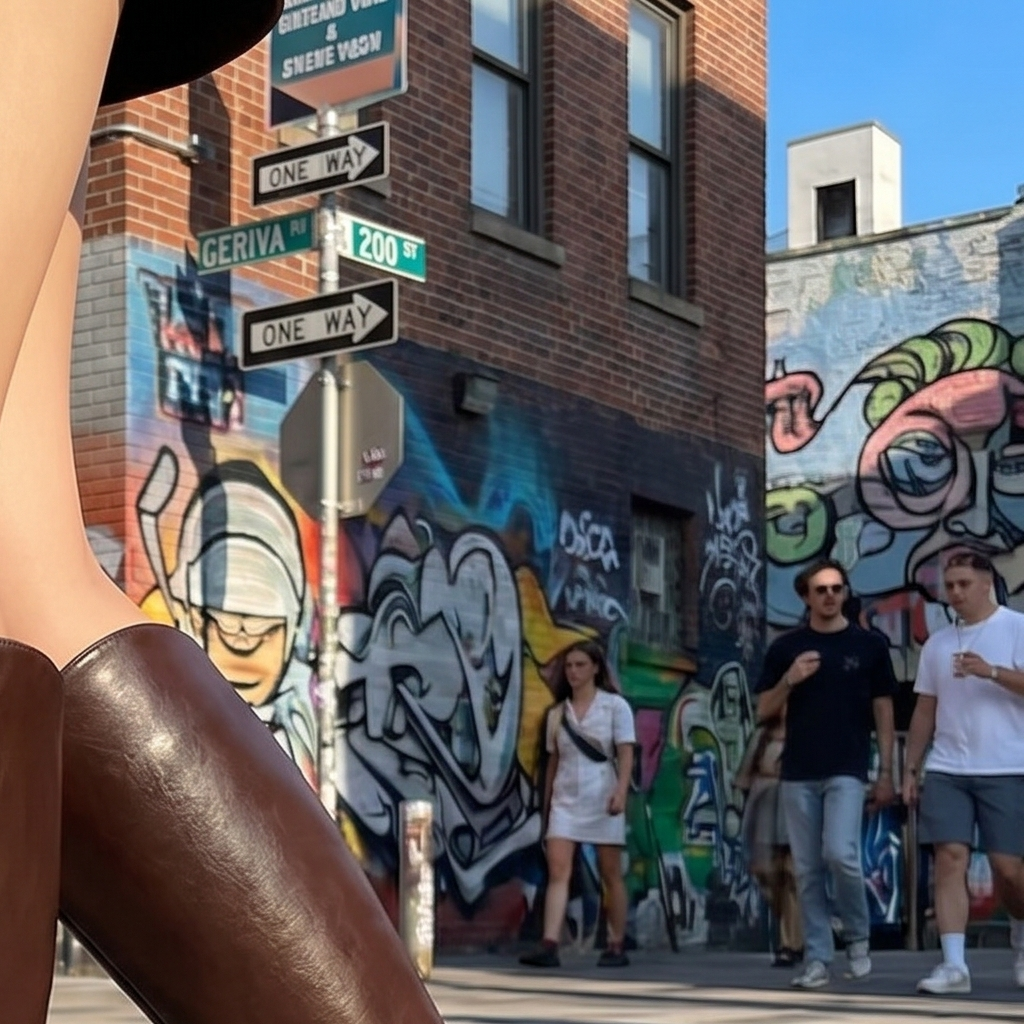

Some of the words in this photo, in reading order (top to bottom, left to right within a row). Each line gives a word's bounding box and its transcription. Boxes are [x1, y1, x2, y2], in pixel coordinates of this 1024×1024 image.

[269, 160, 309, 188] ONE
[326, 145, 366, 174] WAY
[202, 223, 286, 268] GERIVA
[358, 226, 398, 267] 200
[403, 242, 418, 260] ST
[262, 317, 305, 347] ONE
[325, 304, 372, 334] WAY
